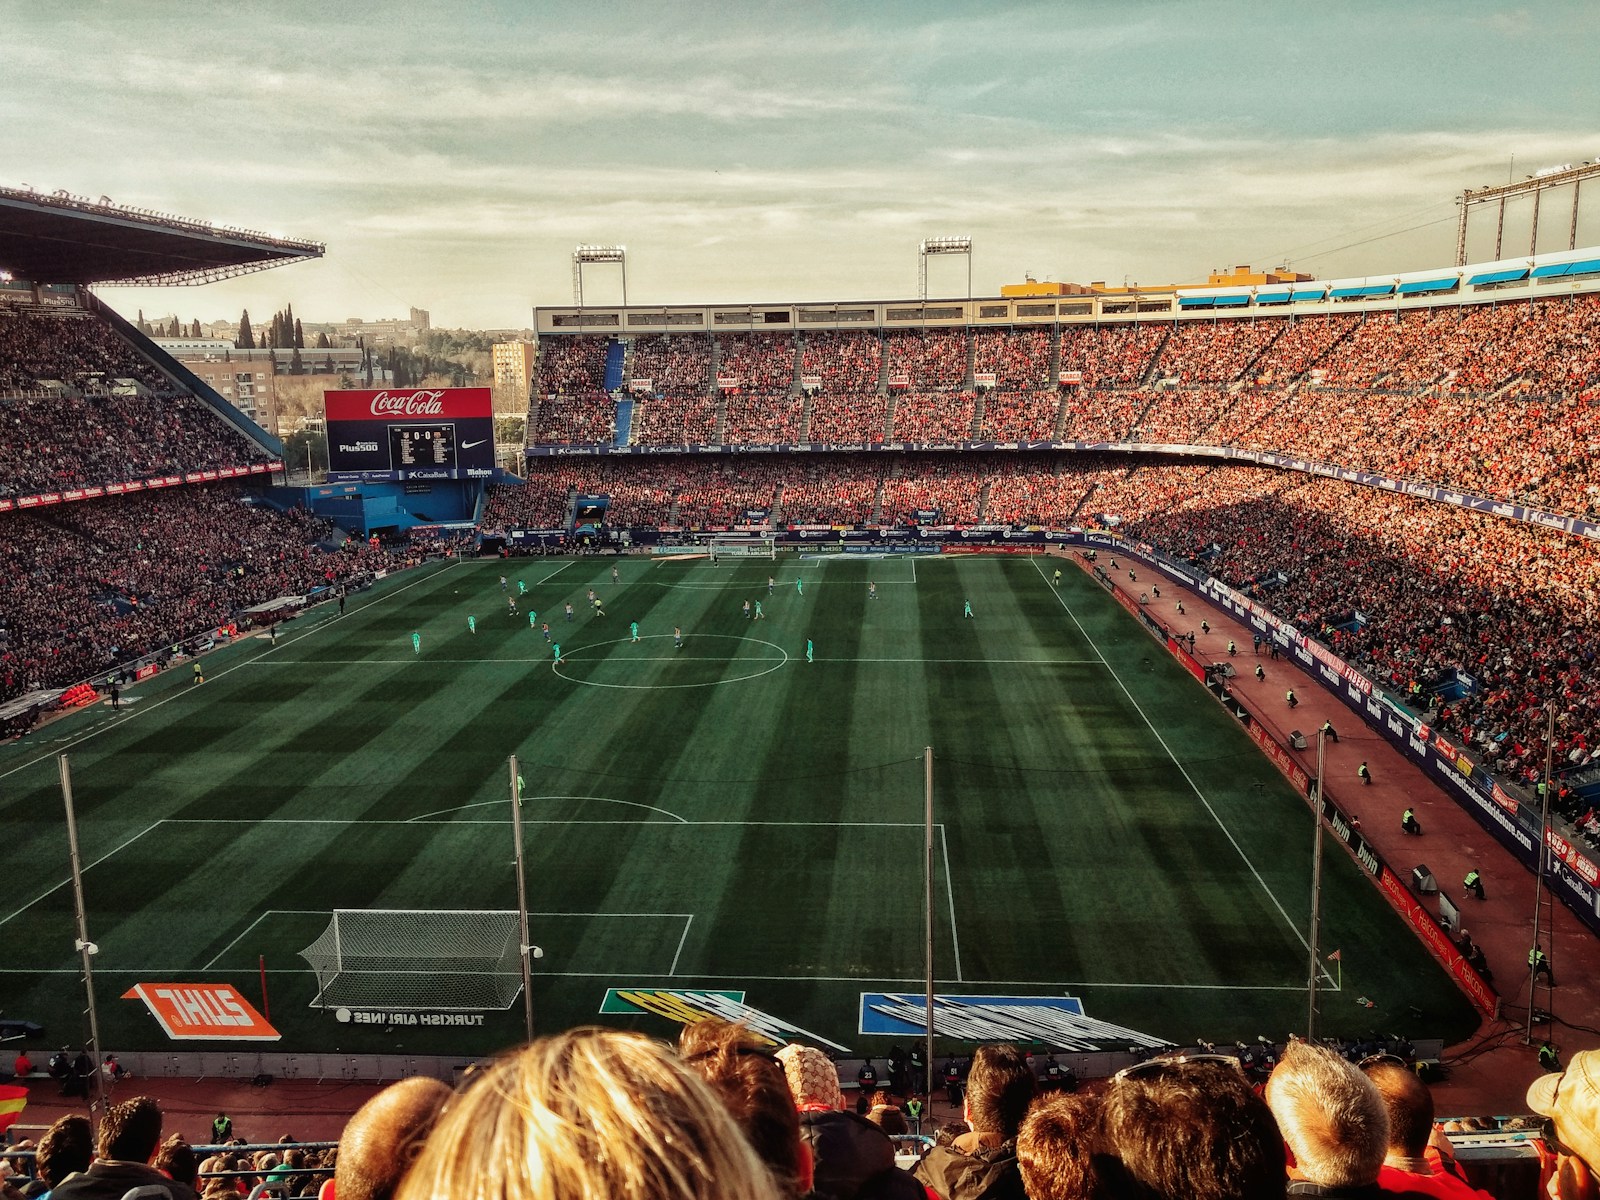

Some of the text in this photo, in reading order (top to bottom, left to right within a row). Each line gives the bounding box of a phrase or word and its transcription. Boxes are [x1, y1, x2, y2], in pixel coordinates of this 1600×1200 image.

[632, 380, 651, 388] MARCA
[719, 379, 738, 387] MARCA
[802, 378, 821, 386] MARCA
[889, 376, 909, 384] MARCA
[975, 374, 996, 382] MARCA
[1060, 372, 1081, 381] MARCA
[370, 390, 446, 416] Coca-Cola
[414, 431, 420, 440] 0
[424, 430, 431, 440] 0
[340, 444, 378, 452] Plus500
[1344, 667, 1370, 692] FABERO
[1388, 714, 1403, 738] bwin
[1410, 732, 1426, 757] bwin
[1332, 810, 1350, 842] bwin
[1357, 840, 1378, 875] bwin
[1562, 866, 1593, 906] CaixaBank
[155, 990, 254, 1026] STIHL
